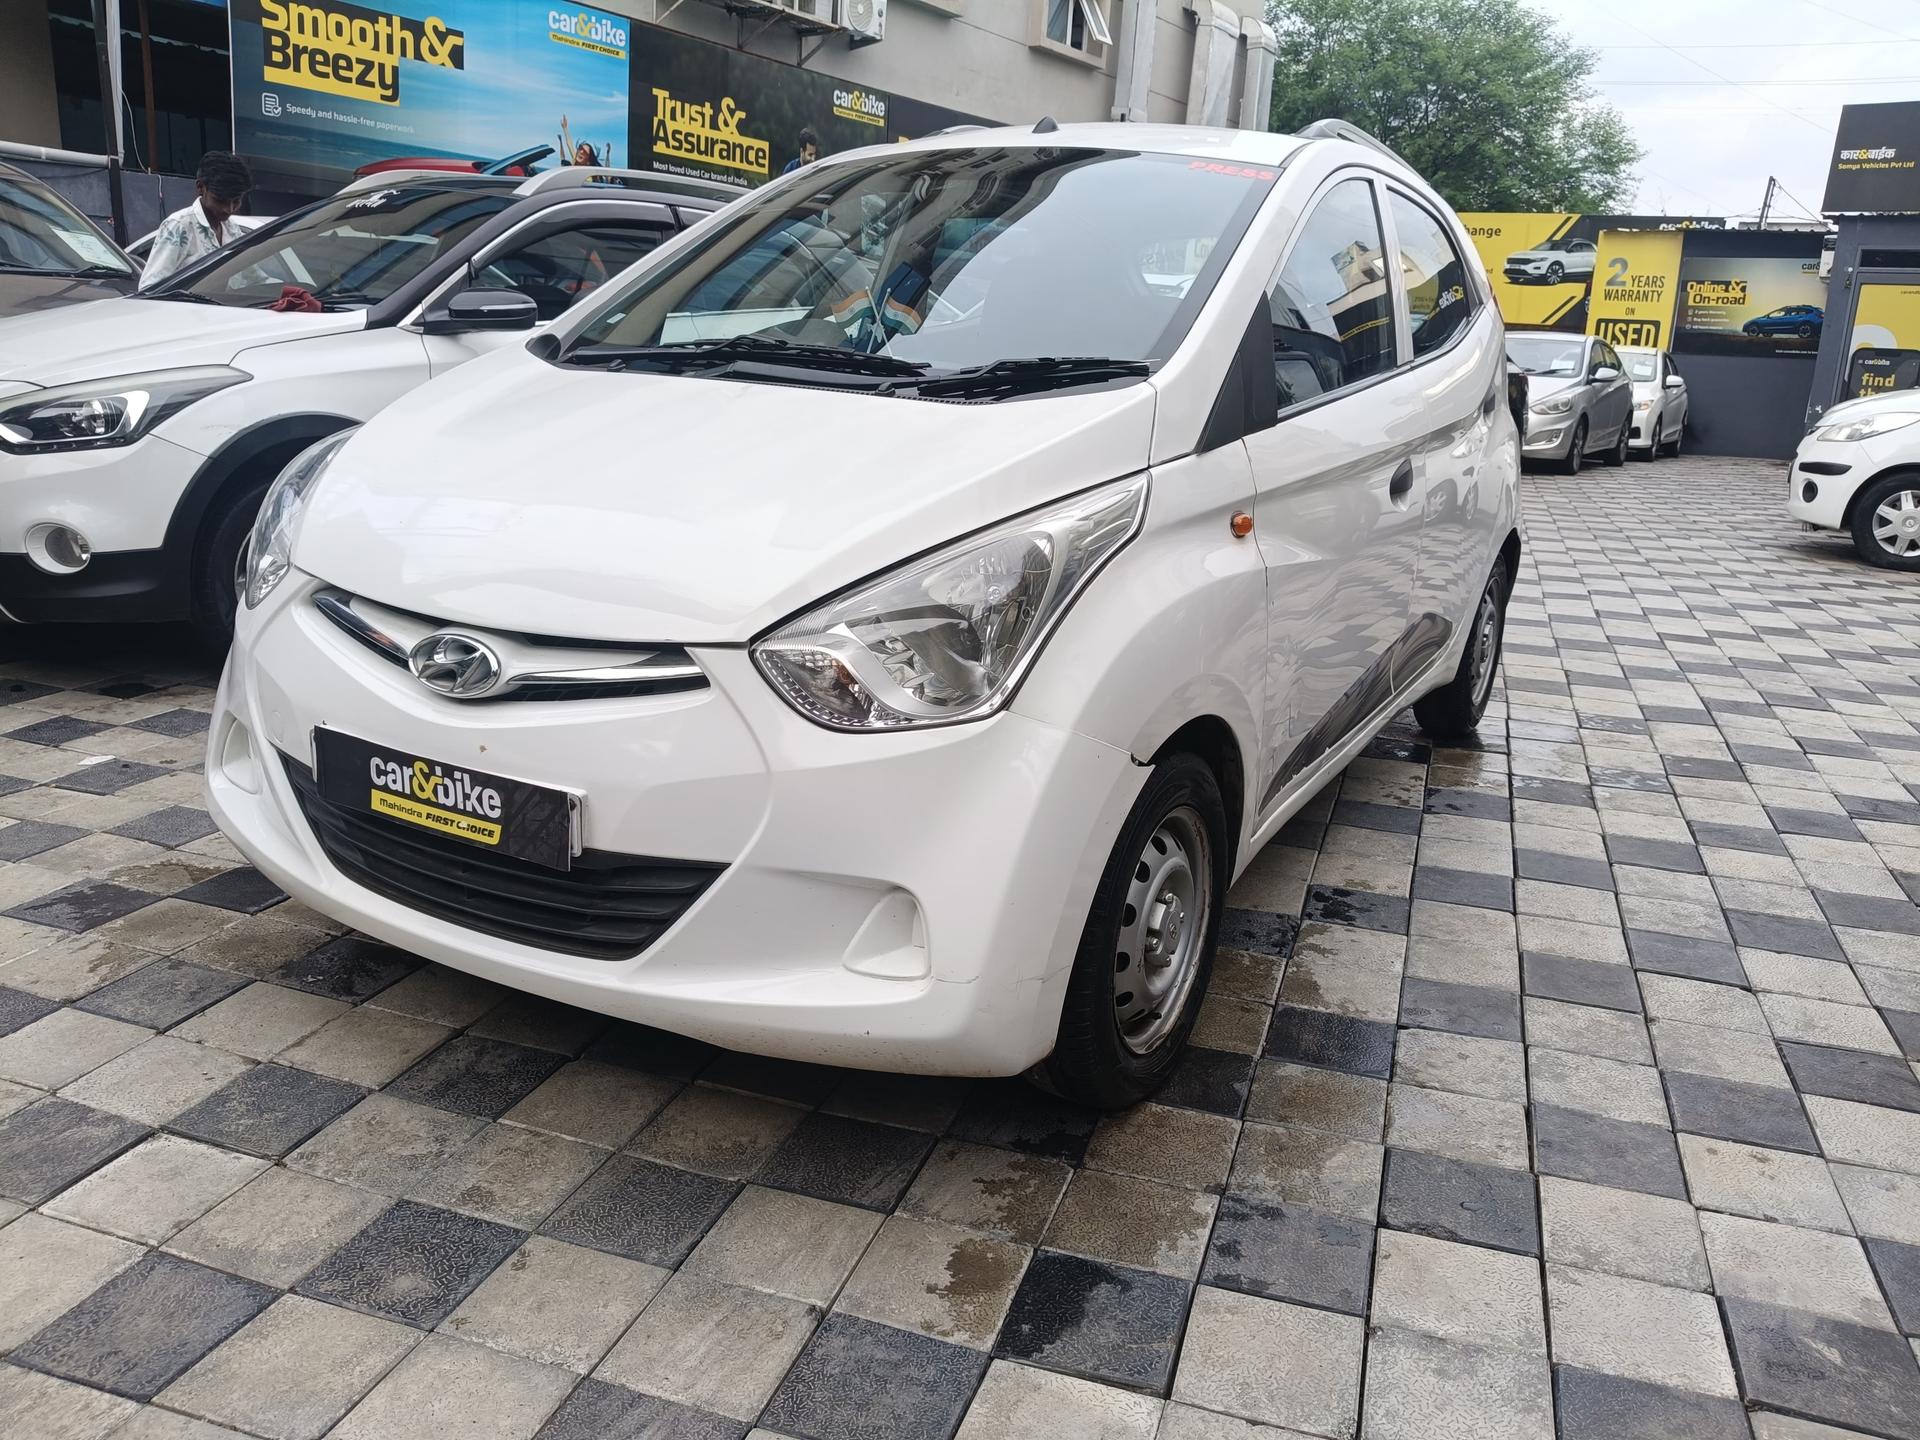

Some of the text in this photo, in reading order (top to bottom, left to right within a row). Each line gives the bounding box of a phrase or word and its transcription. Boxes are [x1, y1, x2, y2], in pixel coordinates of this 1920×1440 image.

[261, 0, 464, 68] Smooth &
[548, 10, 626, 48] car&bike
[581, 41, 599, 52] FIRST
[599, 46, 620, 56] CHOICE
[263, 28, 400, 103] Breezy
[286, 103, 316, 118] Speedy
[317, 109, 332, 119] and
[333, 112, 375, 127] hassle-free
[652, 87, 747, 136] Trust &
[833, 89, 886, 117] car&bike
[654, 119, 767, 168] Assurance
[653, 160, 748, 186] Most loved Used Car brand of India
[1187, 160, 1275, 180] PRESS
[1862, 161, 1889, 169] Vehicles
[1606, 257, 1666, 289] 2 YEARS
[1604, 288, 1664, 303] WARRANTY
[1687, 279, 1748, 294] Online &
[1692, 293, 1747, 305] On-road
[1624, 306, 1636, 316] ON
[1599, 322, 1656, 348] USED
[1861, 372, 1896, 387] find
[370, 756, 502, 819] car&bike
[379, 797, 423, 819] Mahindra
[425, 812, 456, 827] FIRST
